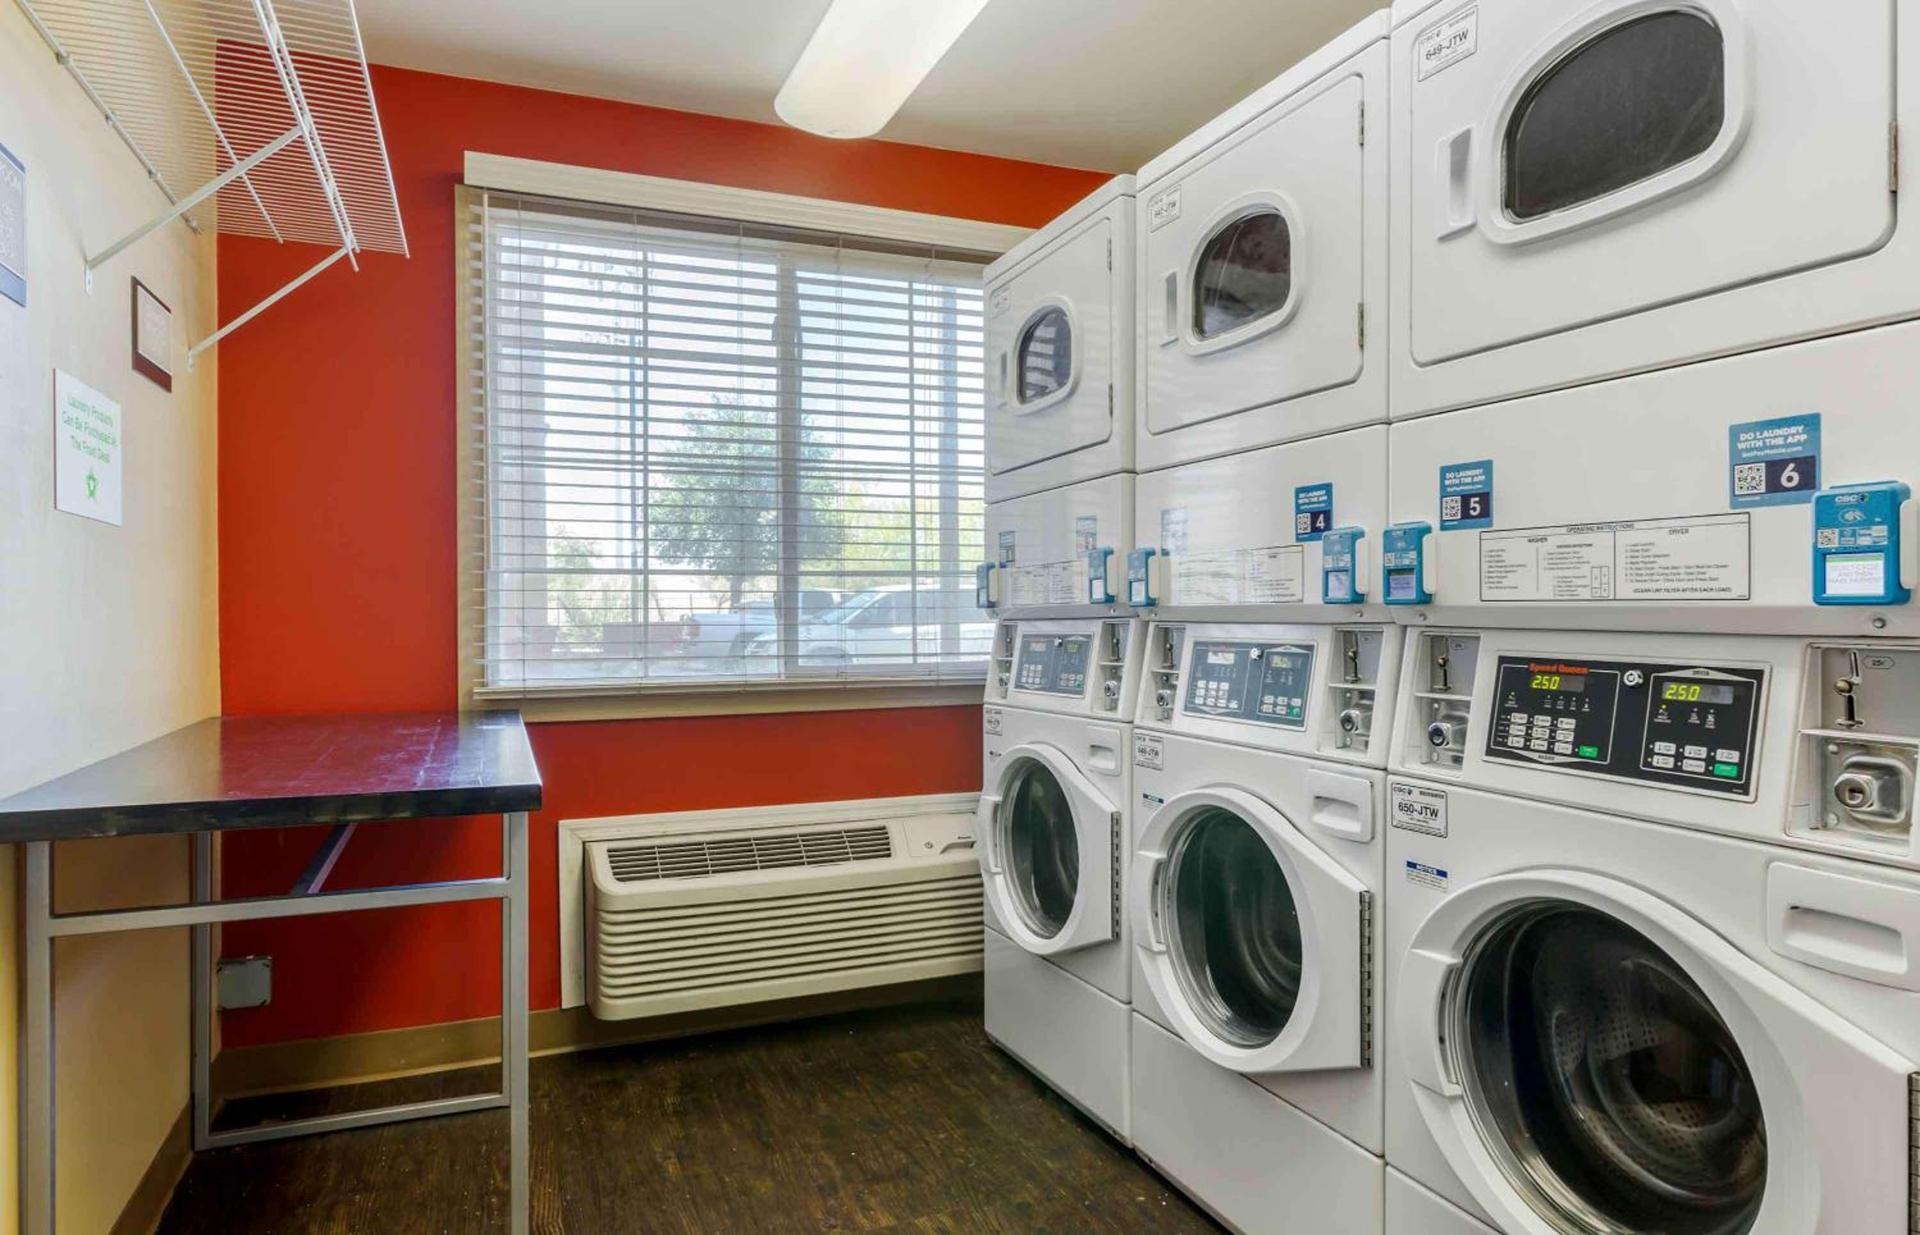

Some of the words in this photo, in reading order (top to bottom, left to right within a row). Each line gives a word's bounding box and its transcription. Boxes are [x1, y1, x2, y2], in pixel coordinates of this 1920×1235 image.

[1425, 28, 1469, 60] 649-JTW
[1740, 431, 1755, 441] DO
[1756, 425, 1805, 439] LAUNDRY
[1737, 441, 1763, 450] WITH
[1765, 437, 1785, 446] THE
[1787, 434, 1808, 444] APP
[1780, 462, 1800, 488] 6
[1469, 497, 1481, 516] 5
[1316, 514, 1325, 529] 4
[1398, 802, 1439, 818] 650-JTW
